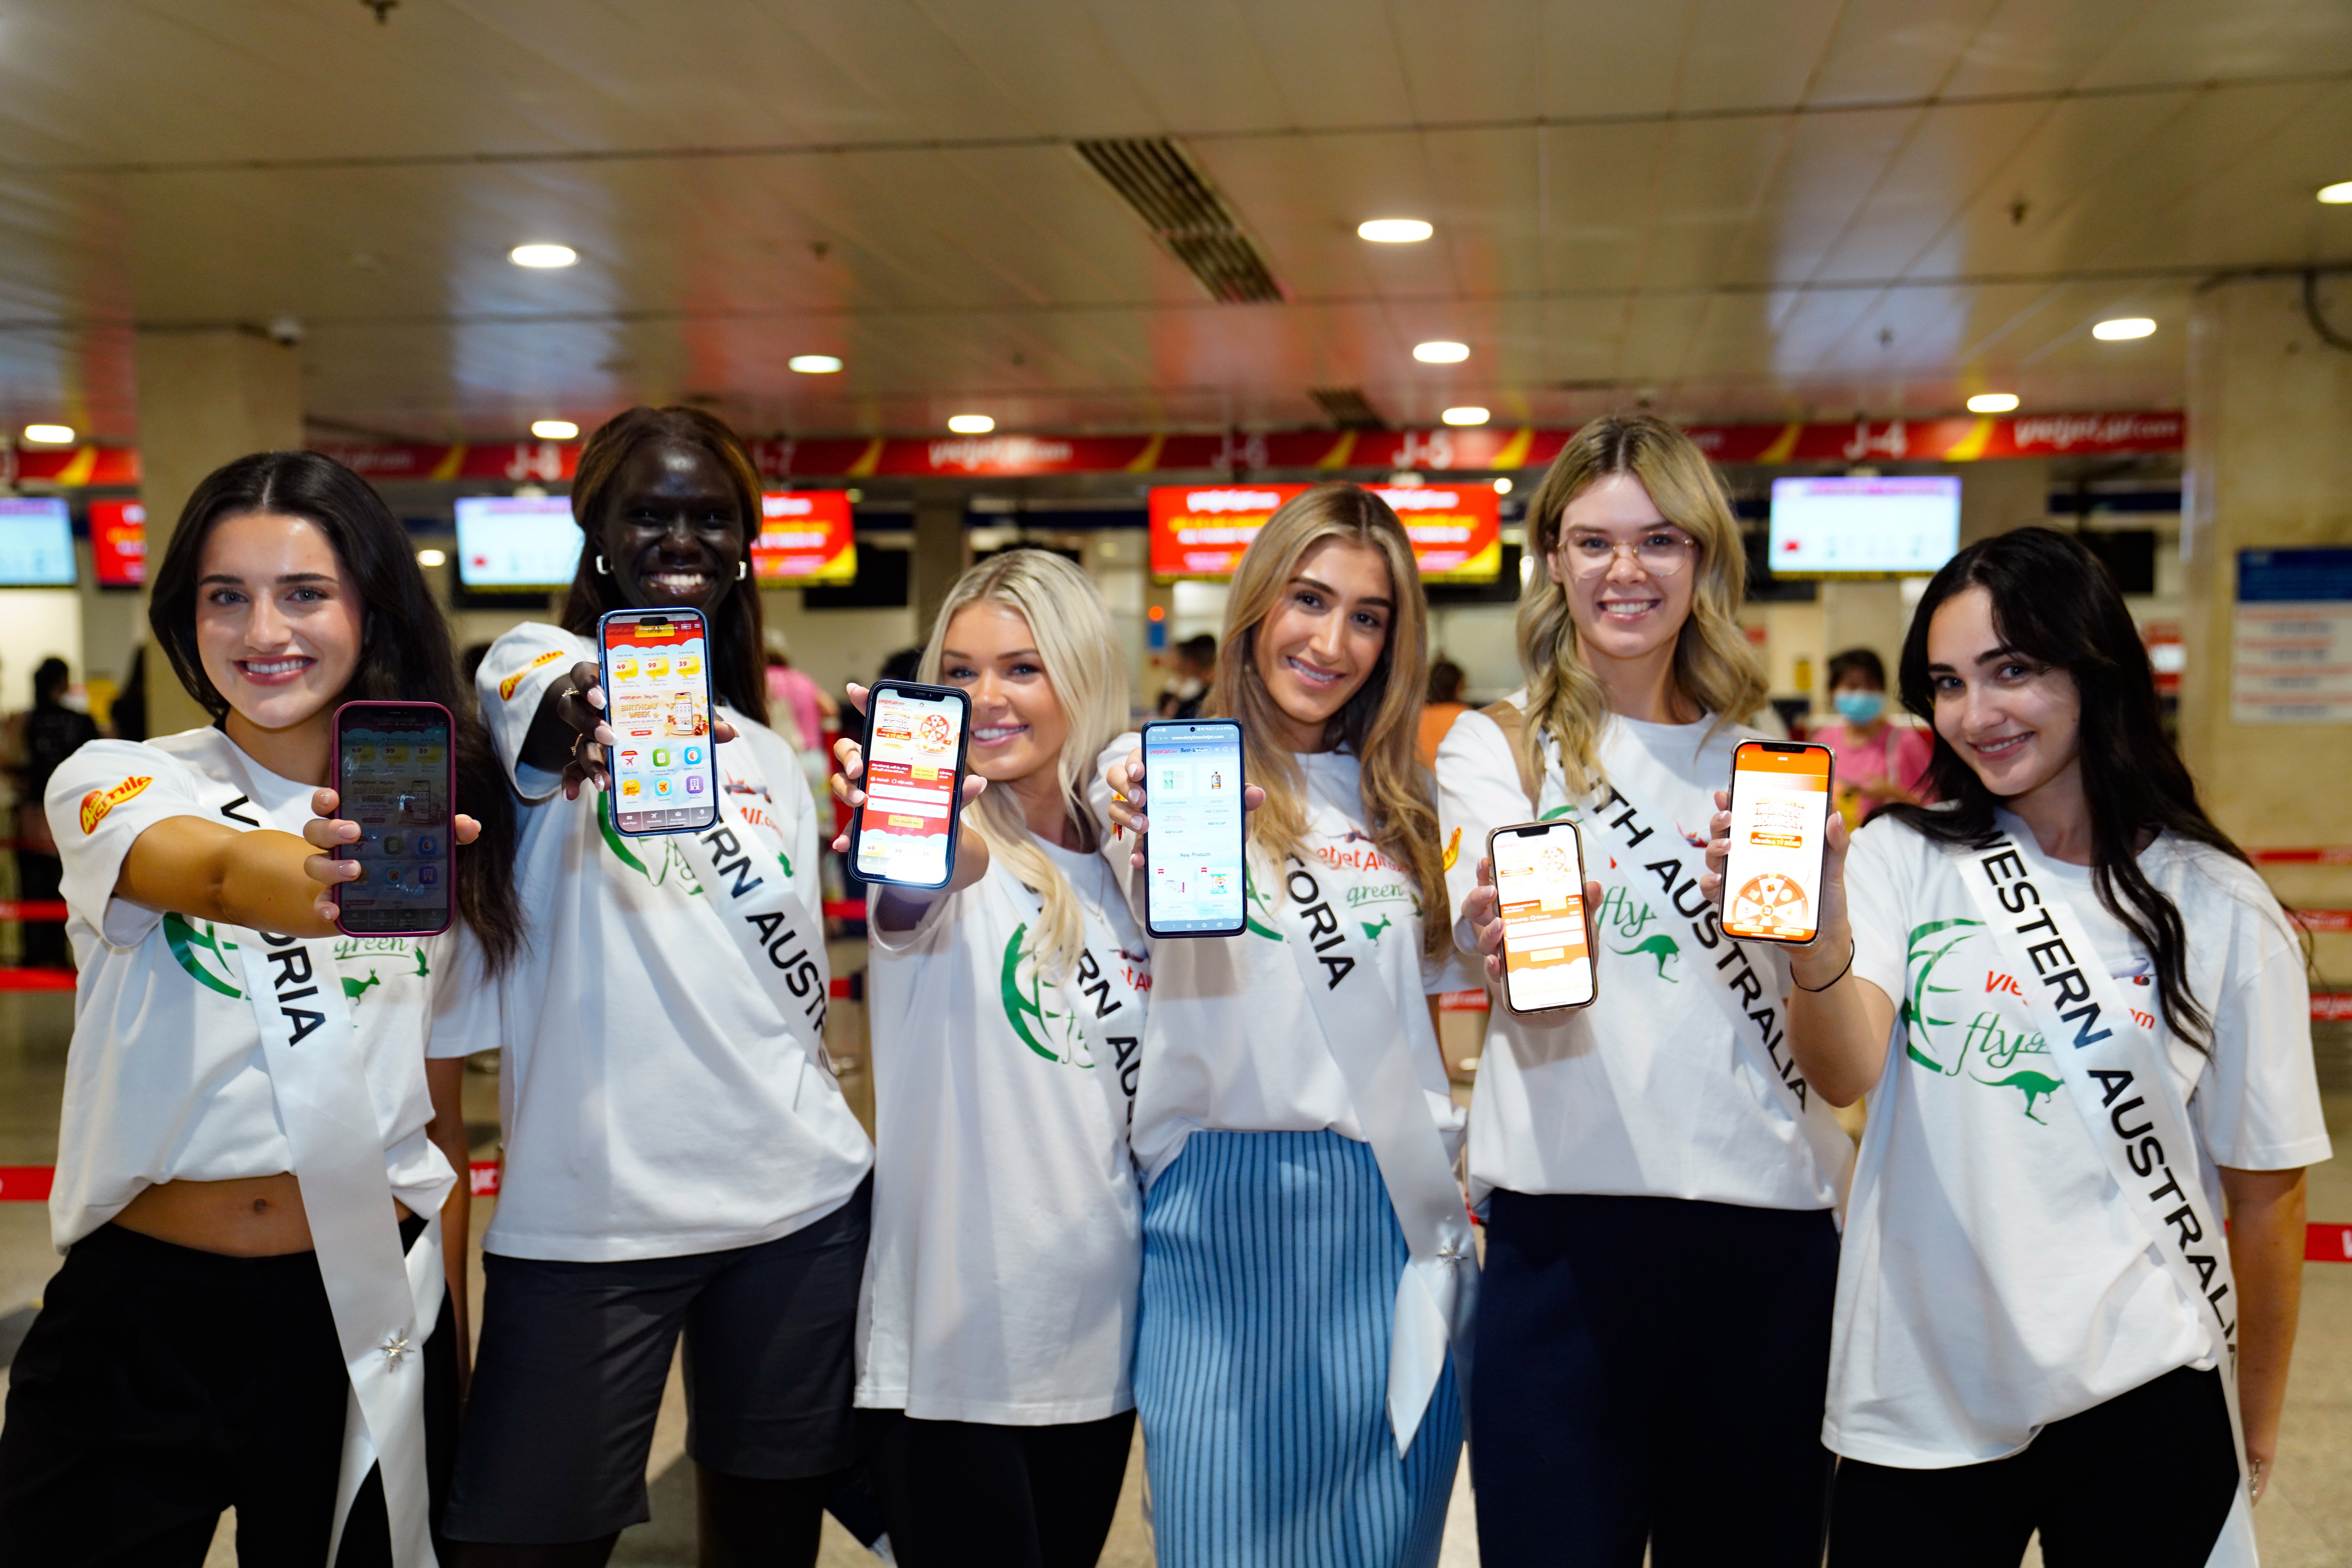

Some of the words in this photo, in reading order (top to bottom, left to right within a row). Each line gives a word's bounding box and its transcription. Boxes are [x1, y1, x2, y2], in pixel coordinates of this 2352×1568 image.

[620, 703, 658, 711] BIRTHDAY
[1347, 884, 1404, 906] green
[1644, 859, 1808, 1114] AUSTRALIA
[1946, 1011, 2027, 1076] fly
